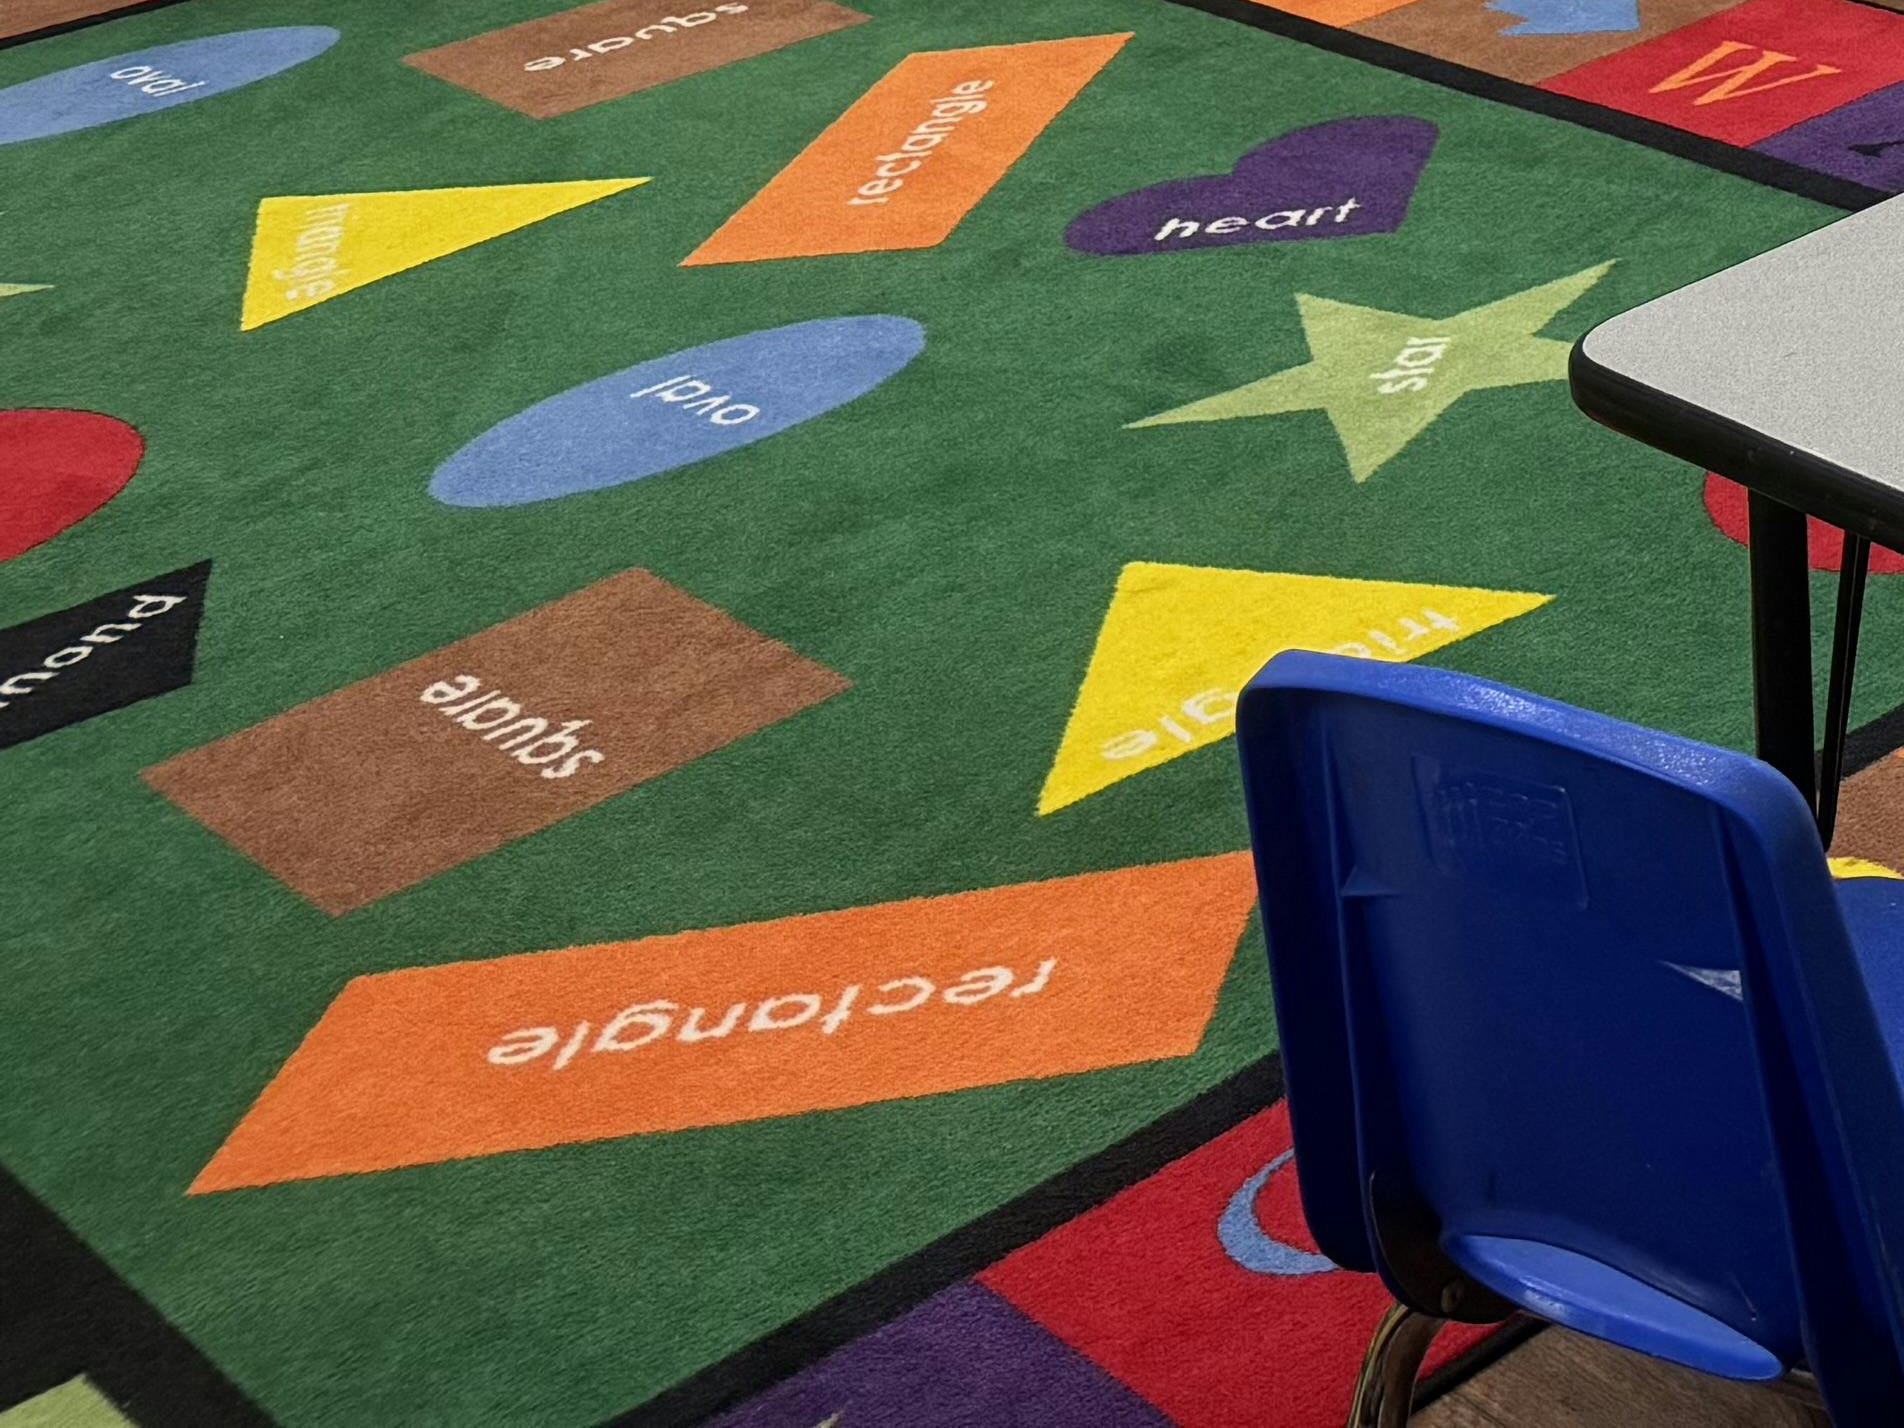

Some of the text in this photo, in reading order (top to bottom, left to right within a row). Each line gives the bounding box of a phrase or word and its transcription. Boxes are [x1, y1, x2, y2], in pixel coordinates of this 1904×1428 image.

[521, 0, 751, 74] square
[108, 62, 208, 98] oval
[1646, 39, 1845, 107] W
[847, 76, 995, 209] rectangle
[1152, 194, 1363, 244] heart
[1376, 332, 1451, 396] star
[628, 372, 763, 428] oval
[417, 673, 607, 781] square
[485, 956, 1058, 1072] rectangle
